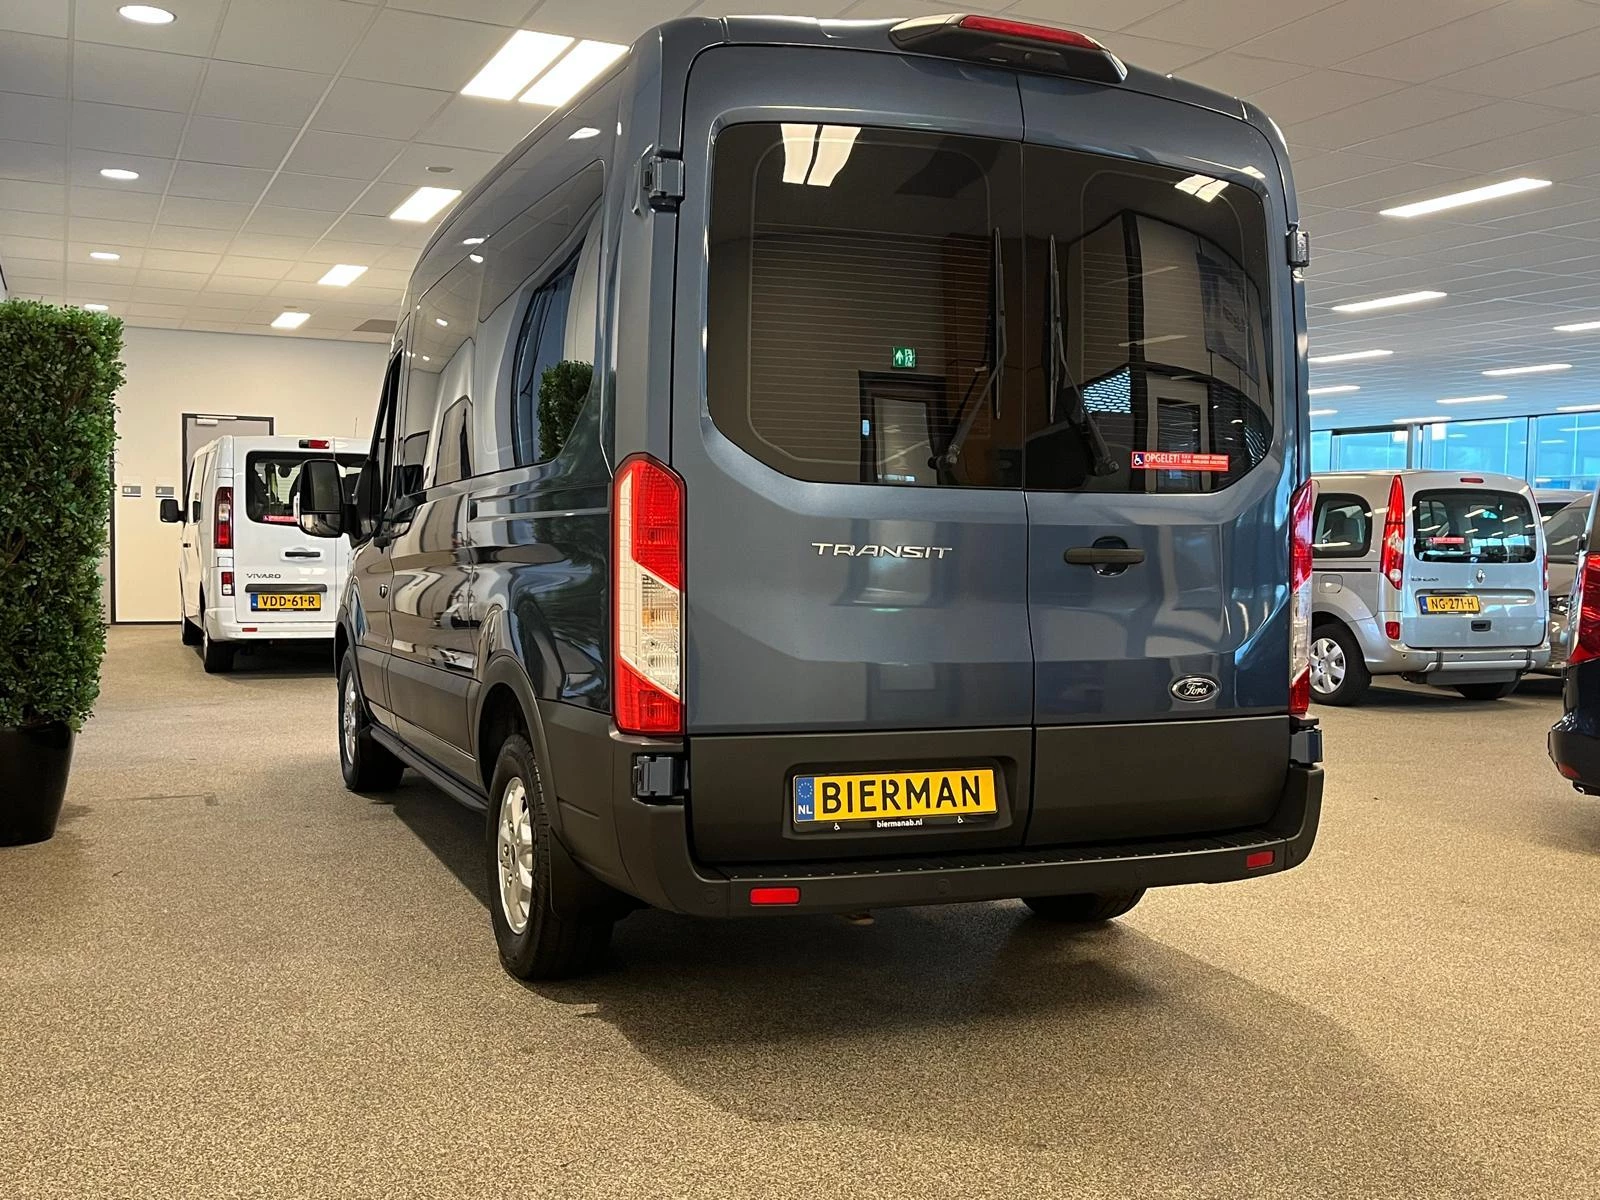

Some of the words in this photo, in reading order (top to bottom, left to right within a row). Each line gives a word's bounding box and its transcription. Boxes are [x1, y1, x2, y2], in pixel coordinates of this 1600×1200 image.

[1144, 452, 1180, 465] OPGELET!
[811, 542, 953, 559] TRANSIT
[261, 595, 315, 607] VDD-61-R
[1431, 597, 1475, 609] NG-271-H
[1183, 682, 1209, 696] Ford
[821, 775, 981, 814] BIERMAN
[797, 804, 813, 815] NL
[876, 818, 923, 828] biermanab.nl
